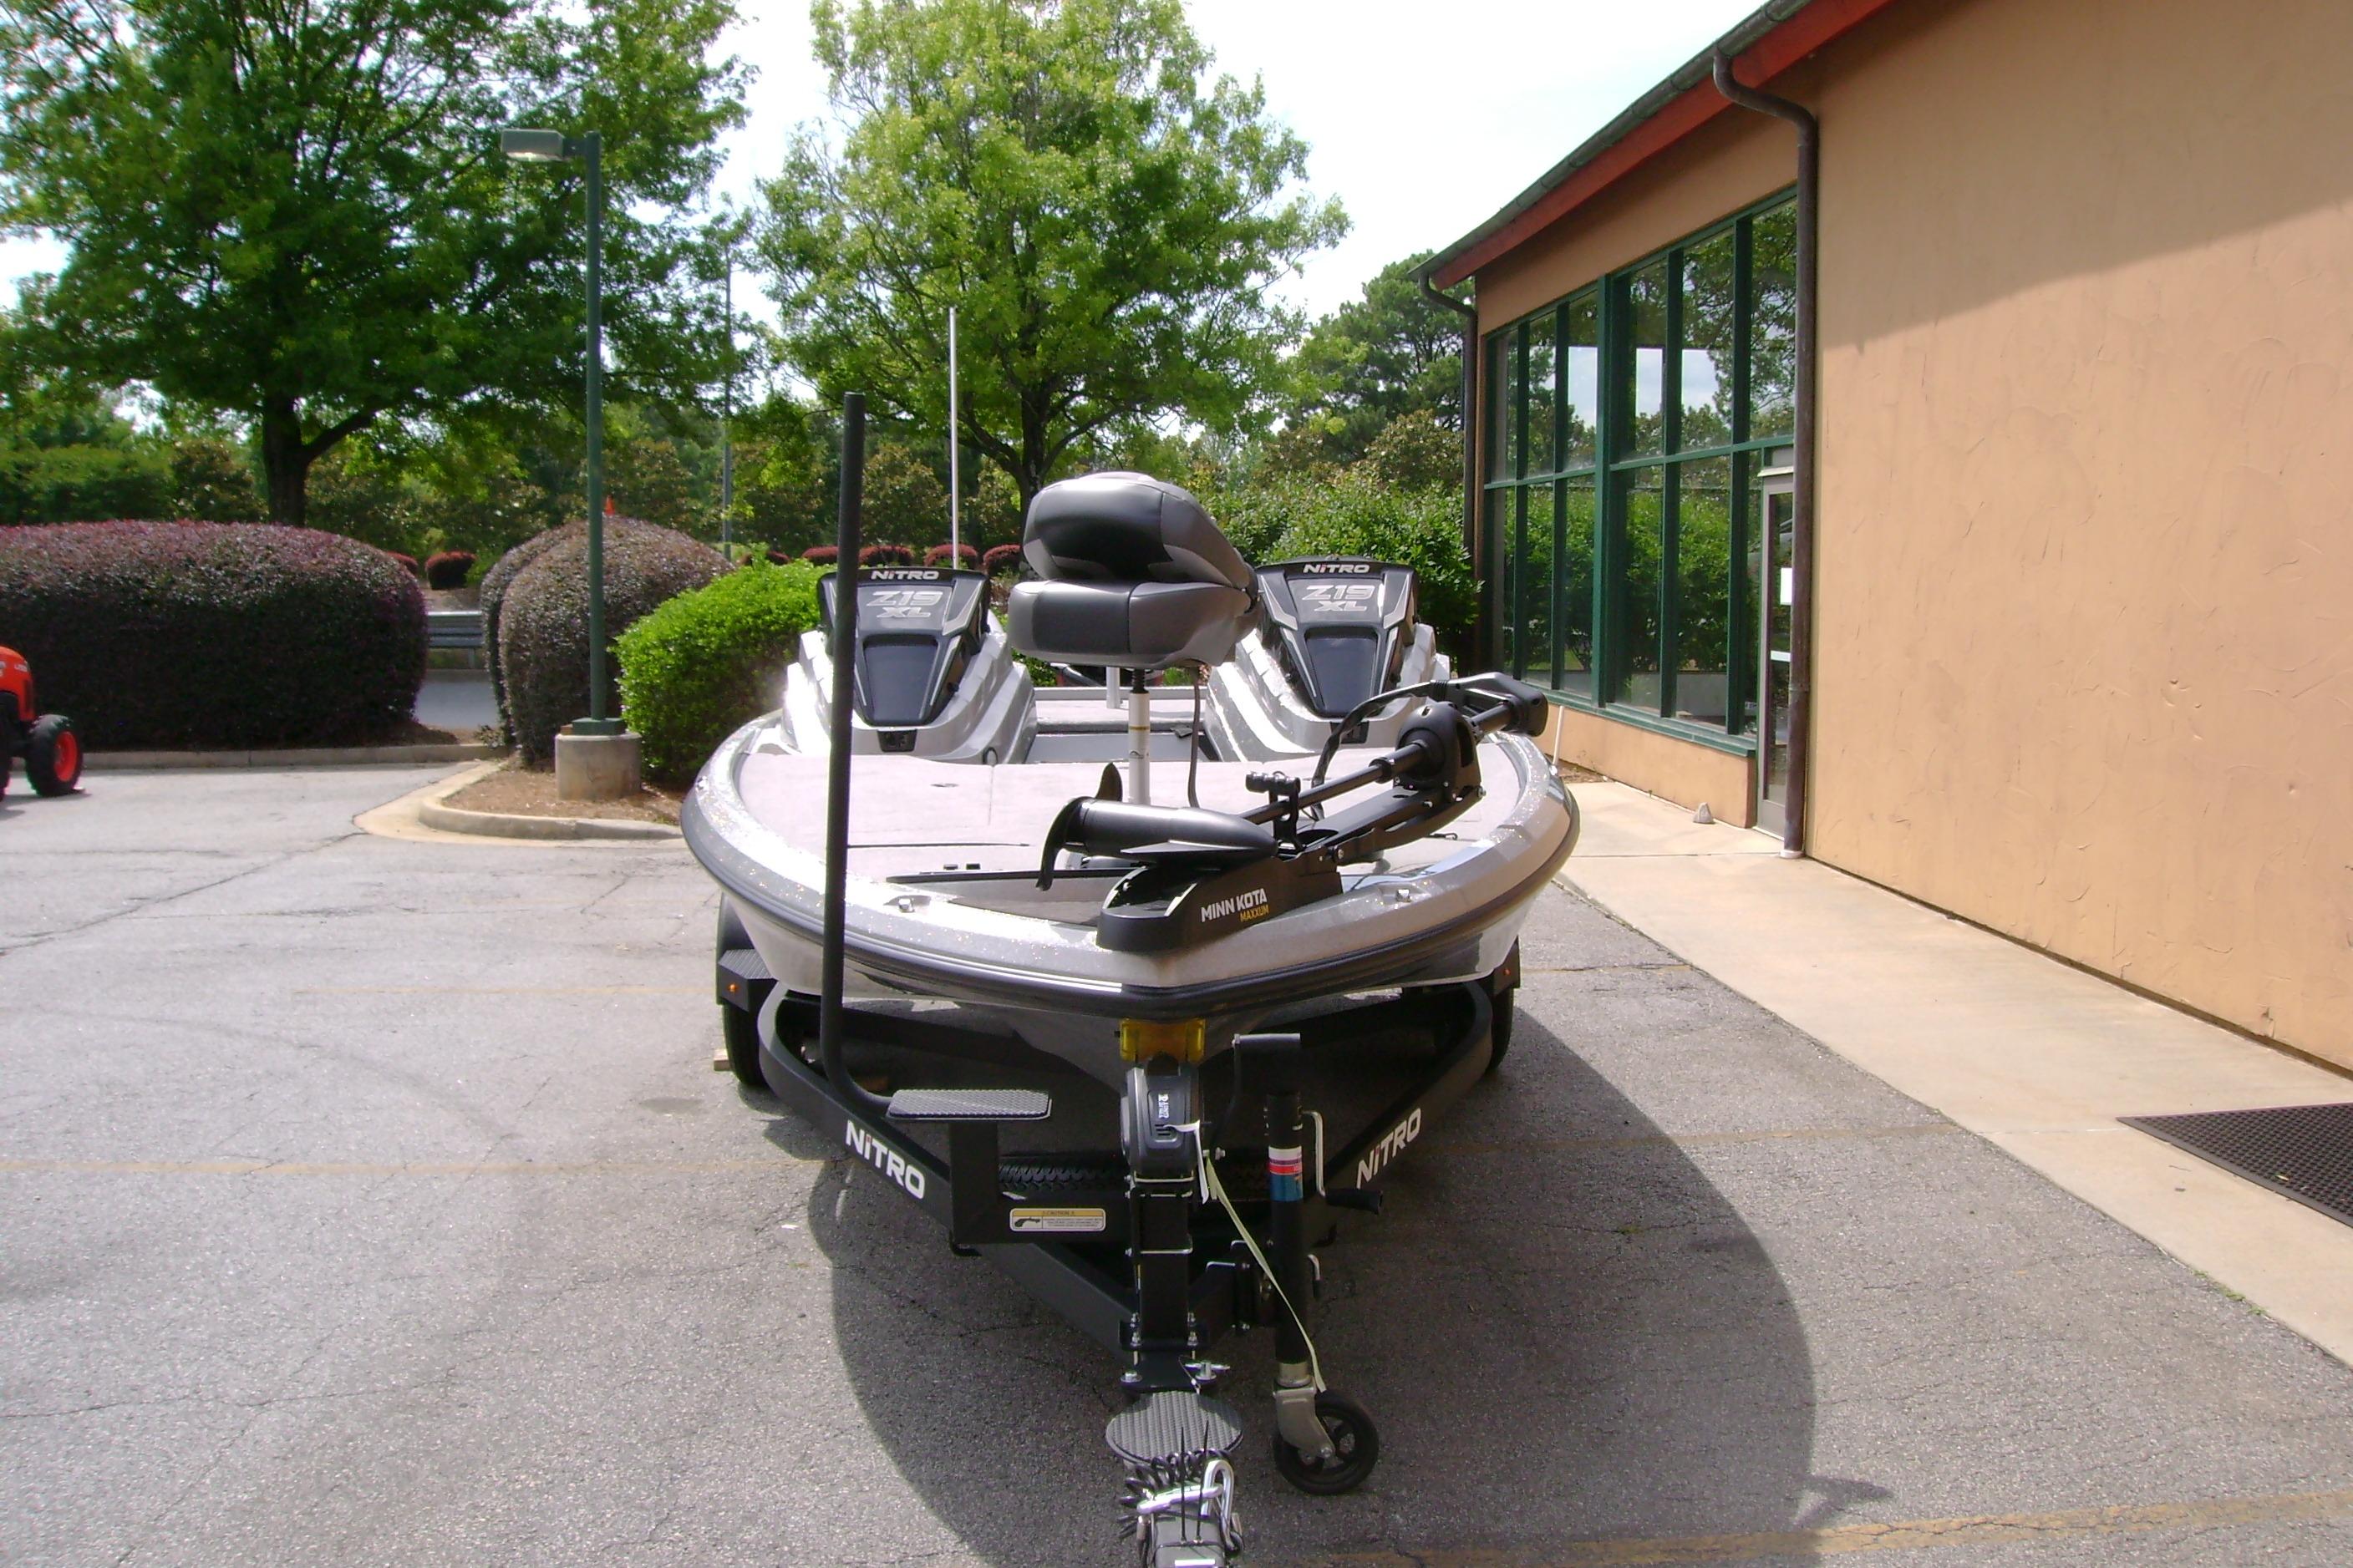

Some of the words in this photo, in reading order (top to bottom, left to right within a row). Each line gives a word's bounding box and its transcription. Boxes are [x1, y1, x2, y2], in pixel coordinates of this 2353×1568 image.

[866, 591, 943, 606] Z19
[1302, 585, 1375, 600] Z19
[876, 606, 932, 617] XL
[1314, 601, 1368, 611] XL
[1201, 898, 1235, 923] MINN
[1236, 888, 1268, 911] KOTA
[1239, 904, 1270, 923] MAXXUM
